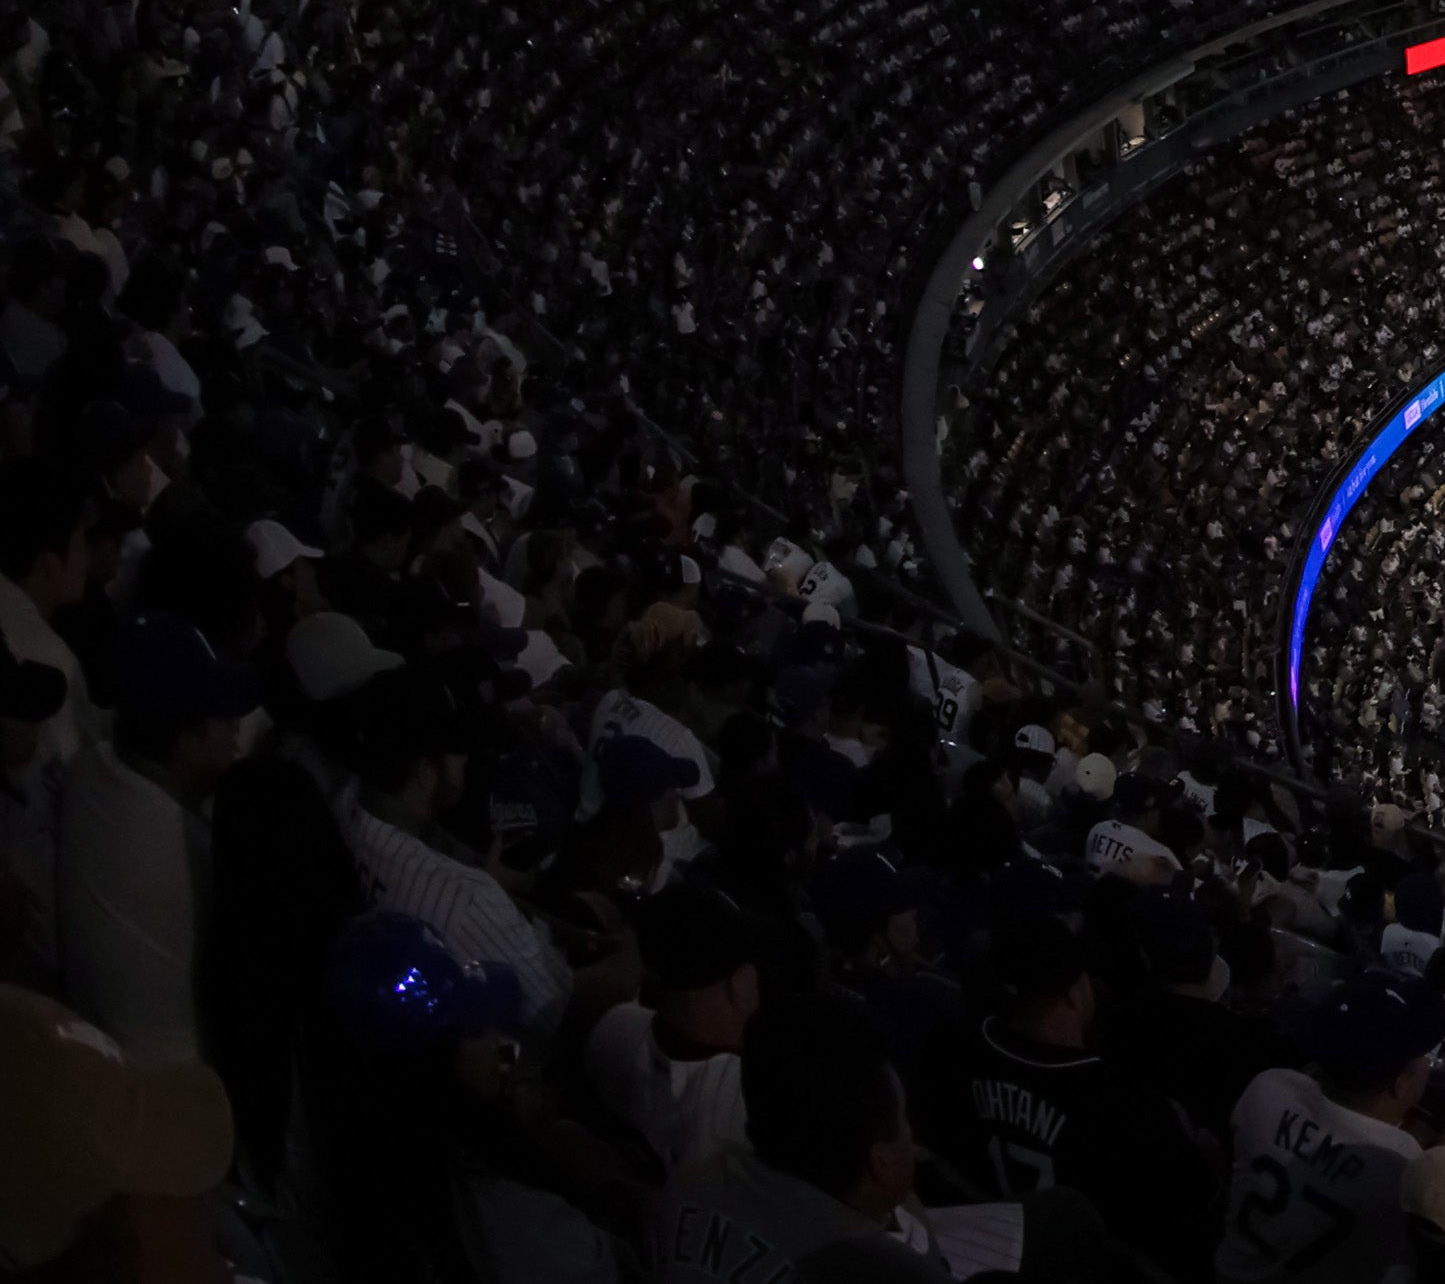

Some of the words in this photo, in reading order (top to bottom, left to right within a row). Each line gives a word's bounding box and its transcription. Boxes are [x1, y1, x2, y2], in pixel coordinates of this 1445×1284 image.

[971, 1078, 1072, 1147] OHTANI
[1274, 1108, 1365, 1184] KEMP
[1238, 1155, 1356, 1271] 27
